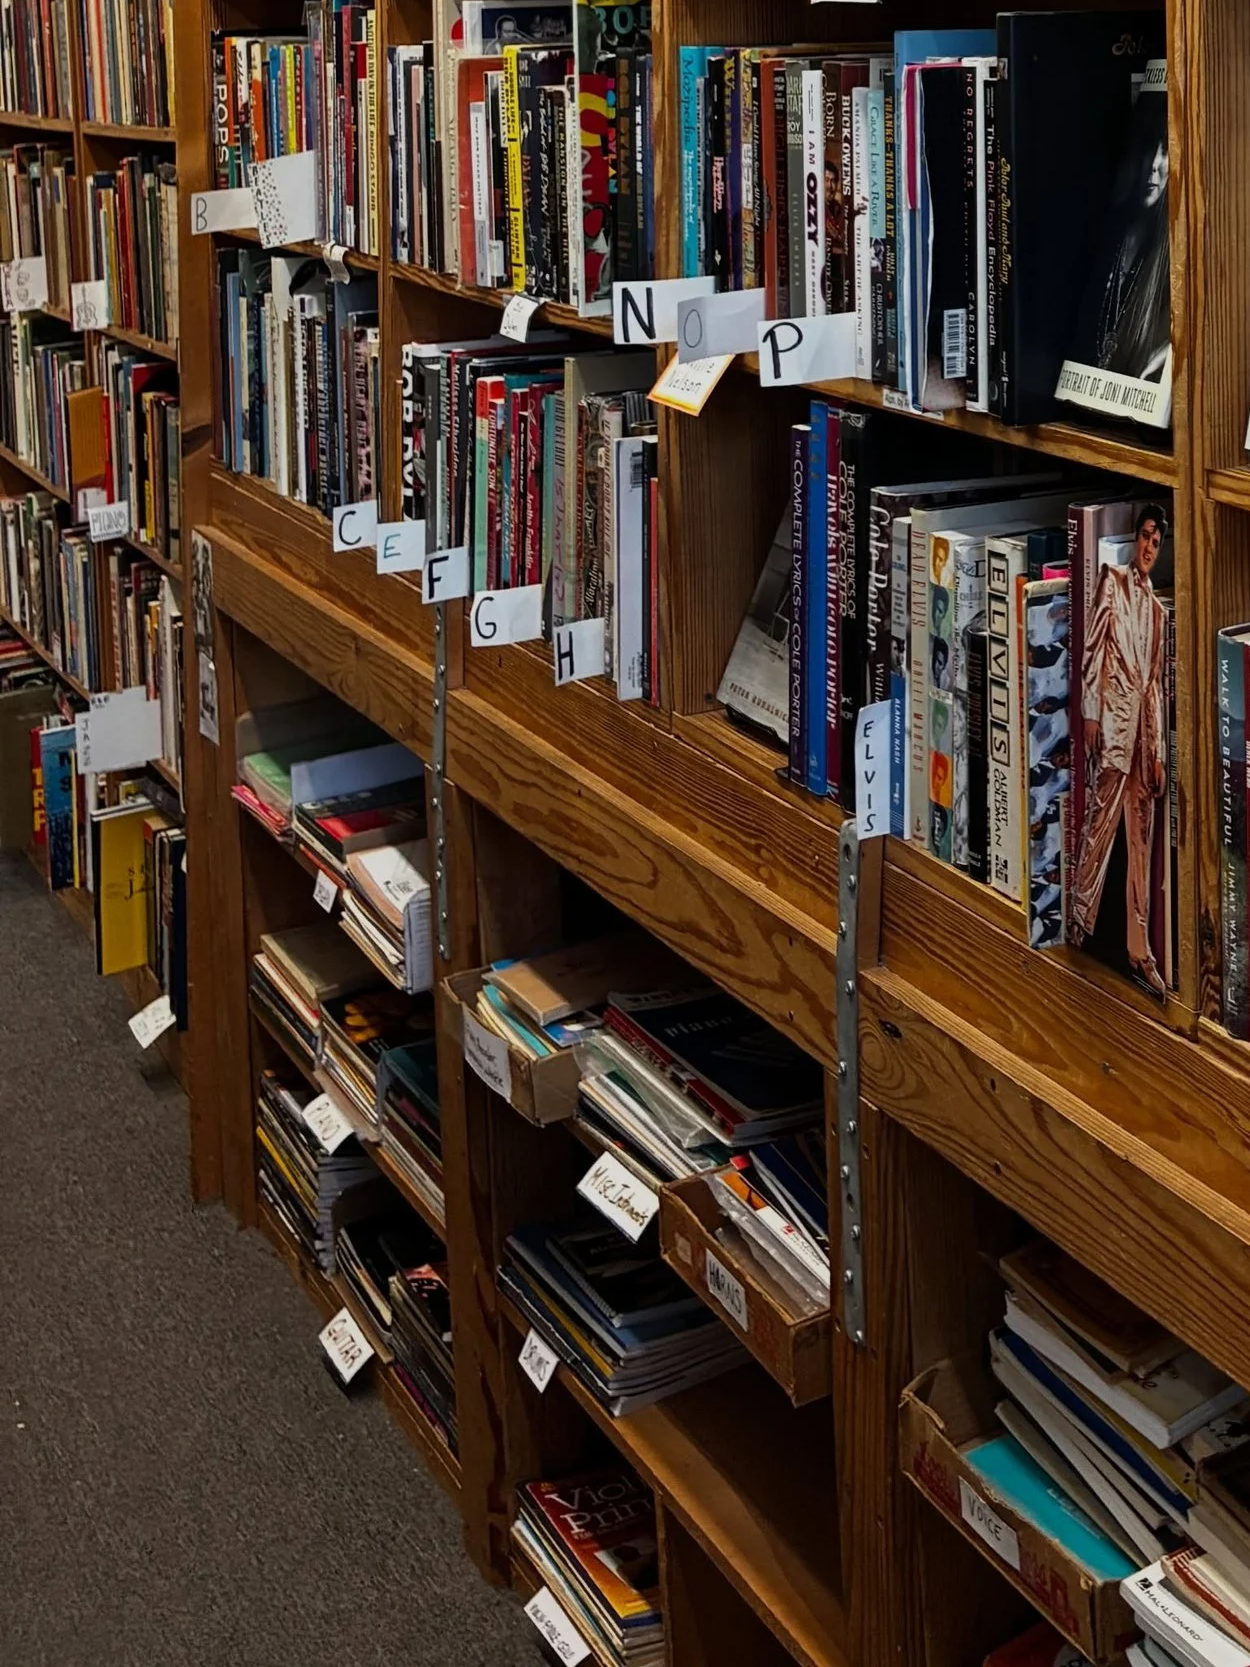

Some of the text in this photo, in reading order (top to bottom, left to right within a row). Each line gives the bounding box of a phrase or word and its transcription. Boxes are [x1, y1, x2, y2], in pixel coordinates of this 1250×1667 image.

[217, 84, 229, 164] POPS
[195, 197, 208, 232] B
[807, 172, 819, 247] OZZY
[622, 287, 656, 342] N
[684, 309, 703, 348] O
[762, 322, 803, 379] P
[338, 511, 357, 546] C
[383, 535, 401, 558] E
[1067, 517, 1078, 557] Elvis
[427, 556, 450, 600] F
[475, 596, 497, 639] G
[556, 631, 574, 680] H
[989, 553, 1009, 766] ELVIS
[863, 719, 878, 832] ELVIS
[709, 1262, 741, 1314] HORNS
[966, 1494, 1003, 1543] VOICE
